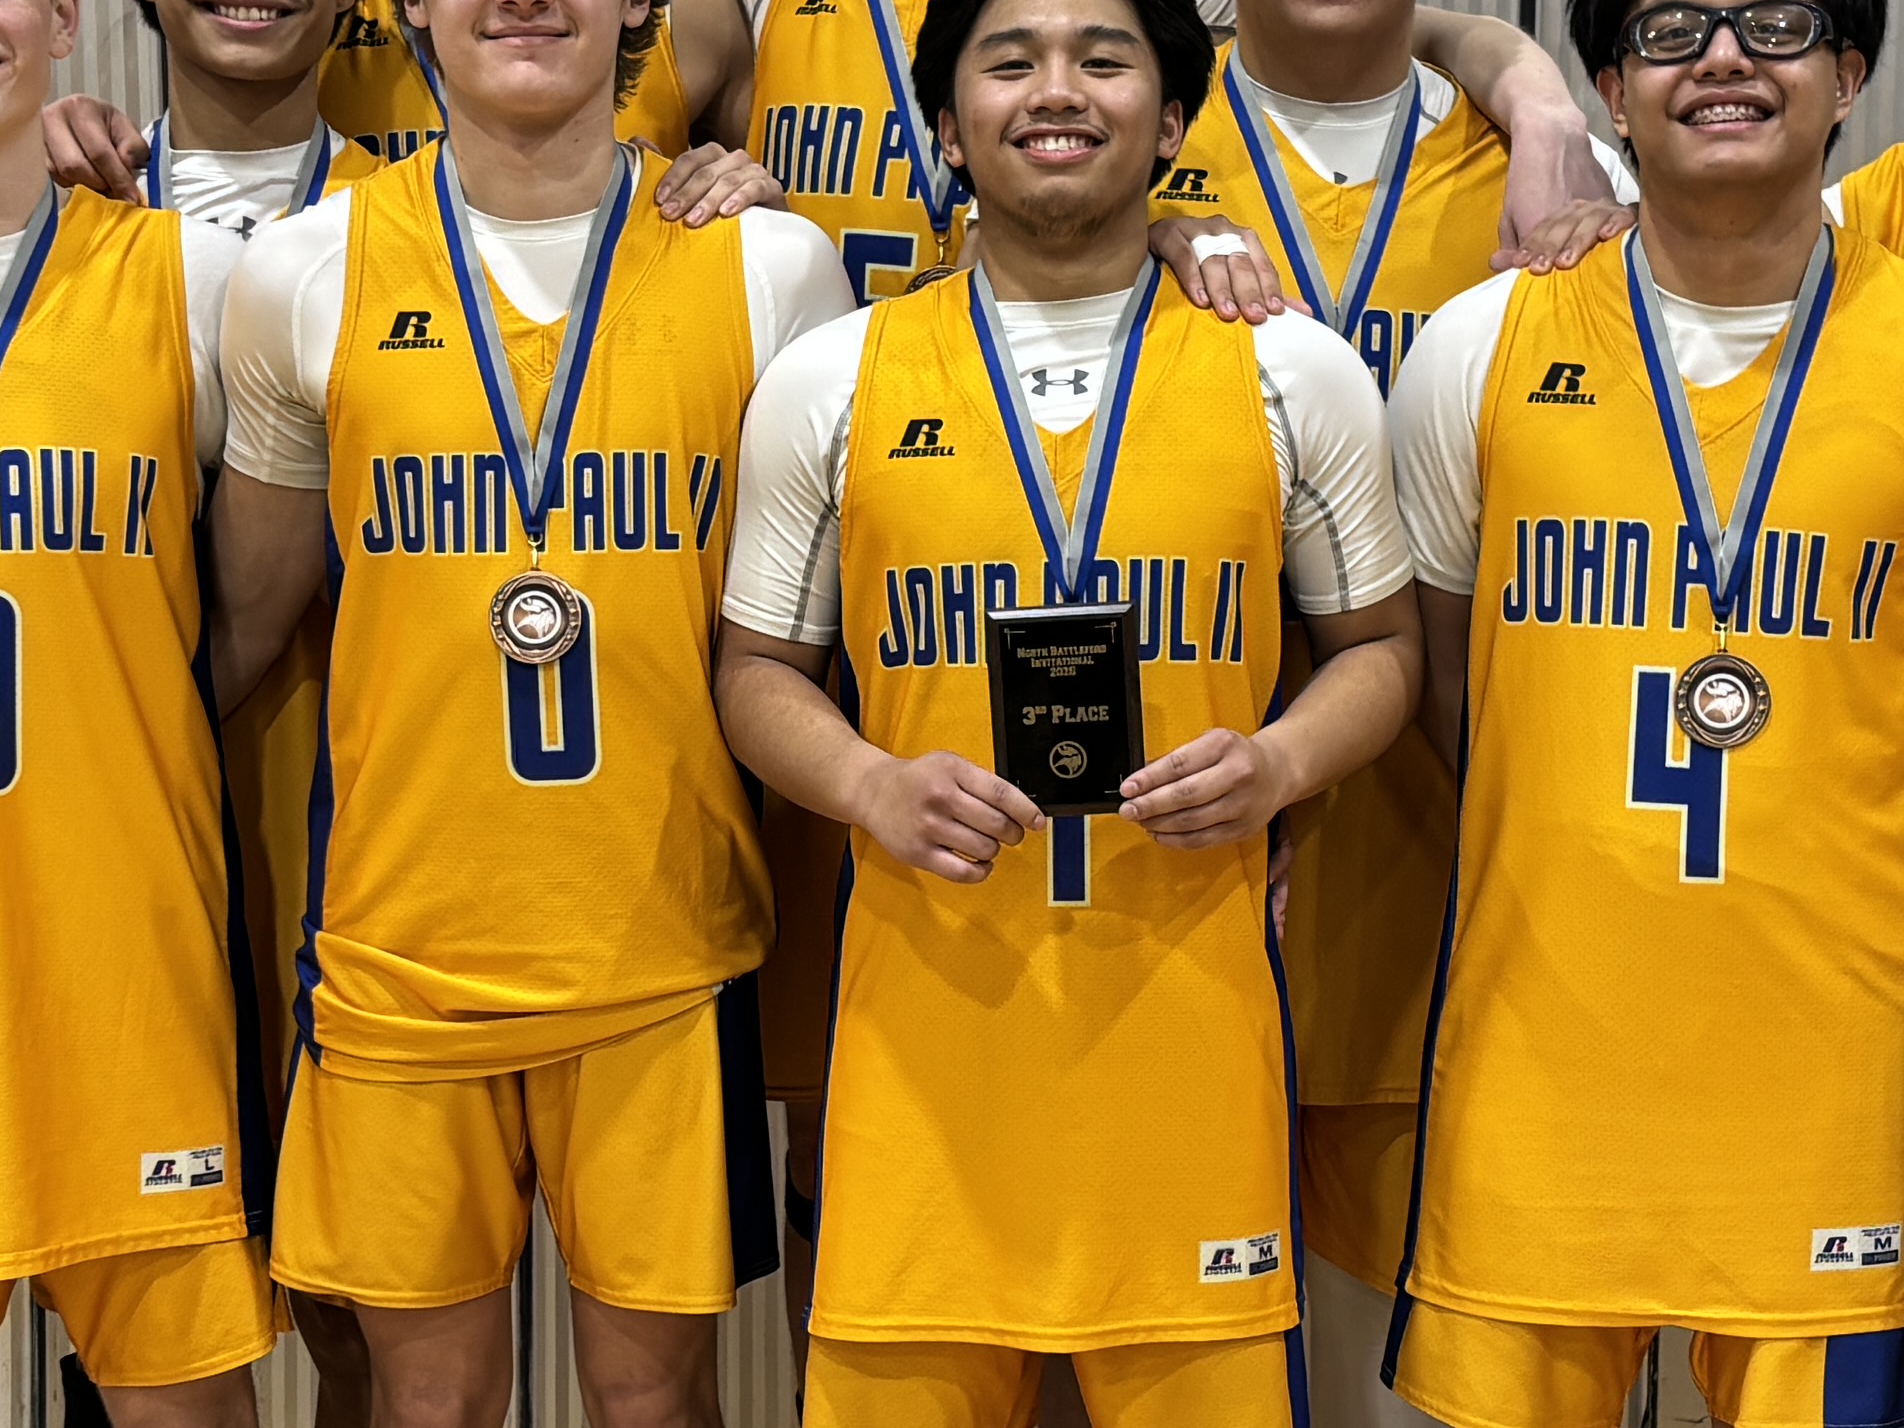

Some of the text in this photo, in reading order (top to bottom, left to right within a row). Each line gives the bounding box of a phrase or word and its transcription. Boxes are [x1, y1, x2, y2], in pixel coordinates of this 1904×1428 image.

[377, 338, 445, 351] RUSSELL
[1527, 392, 1596, 405] RUSSELL
[888, 446, 955, 459] RUSSELL
[361, 452, 509, 556] JOHN
[1502, 517, 1652, 630] JOHN
[1849, 537, 1898, 642] II
[1051, 705, 1109, 723] PLACE
[1625, 664, 1728, 884] 4
[1874, 1236, 1892, 1250] M
[1259, 1244, 1273, 1260] M
